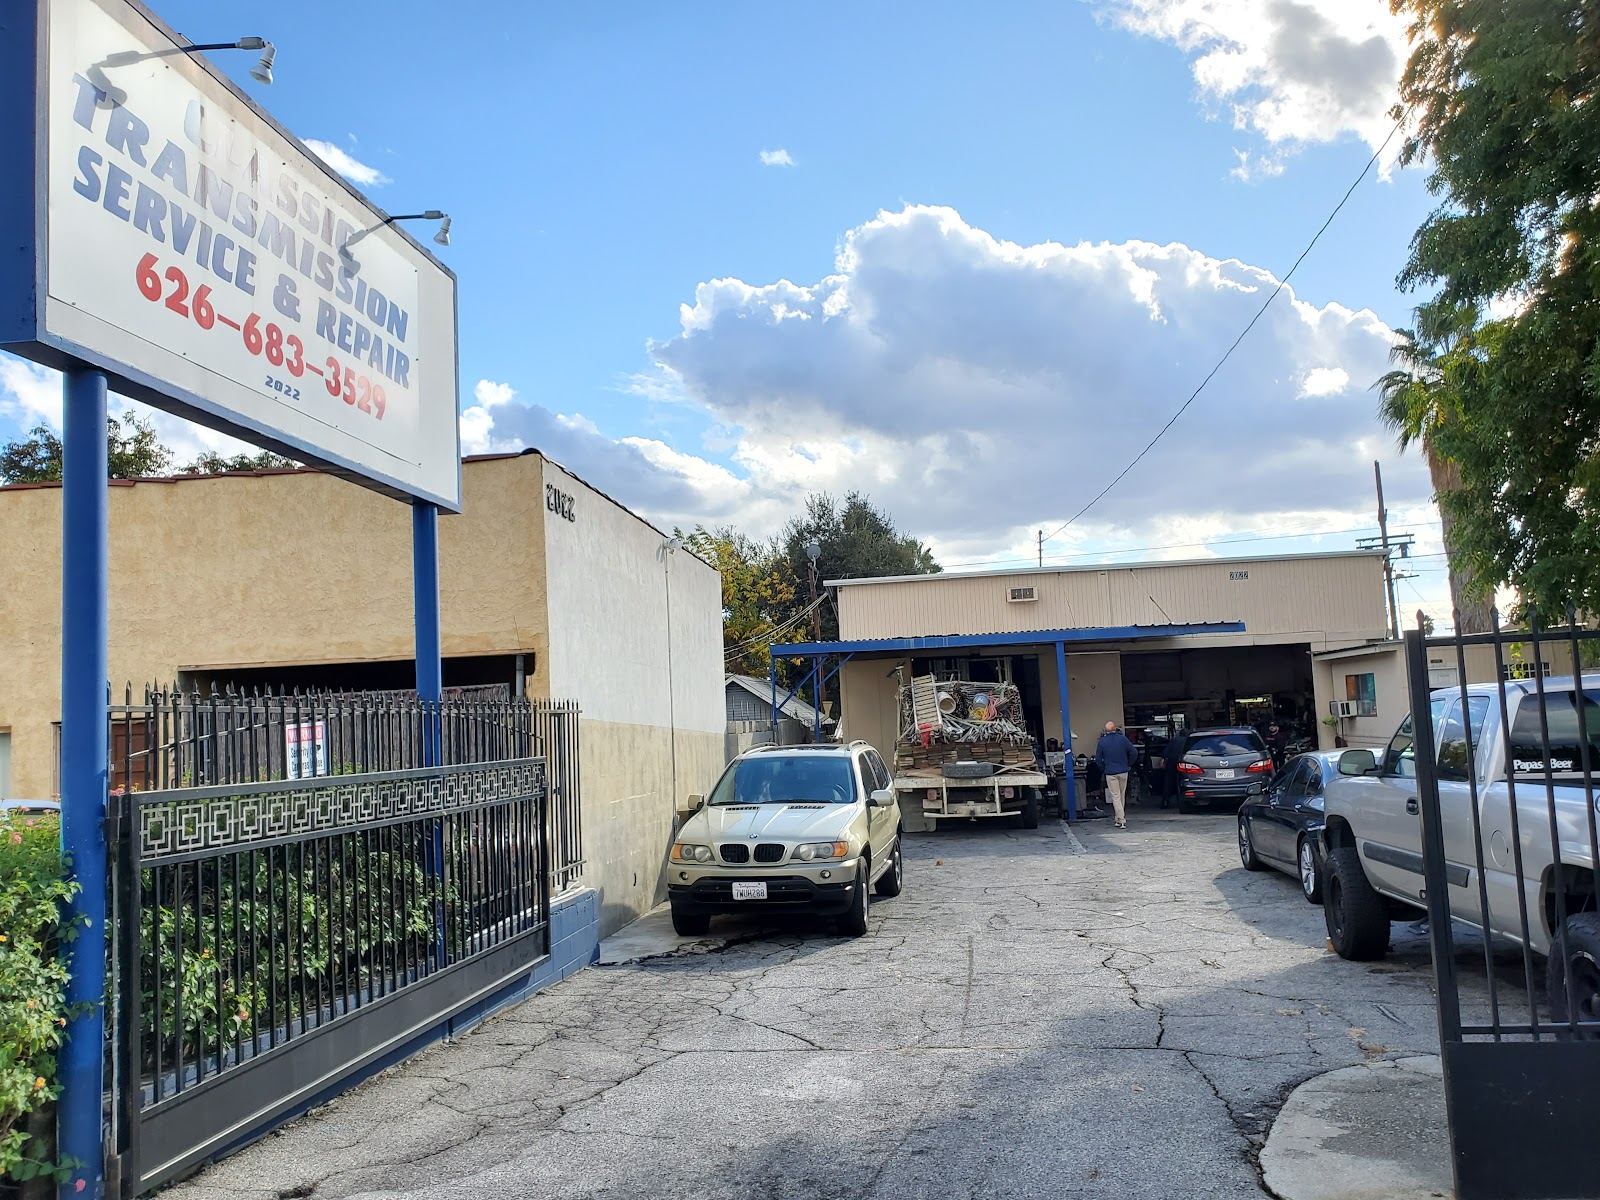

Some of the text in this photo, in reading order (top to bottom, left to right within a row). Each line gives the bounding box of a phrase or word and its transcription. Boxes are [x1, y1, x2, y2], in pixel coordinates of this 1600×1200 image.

[72, 72, 408, 343] TRANSMISSION
[73, 145, 410, 389] SERVICE & REPAIR
[135, 251, 386, 421] 626-683-3529
[265, 375, 300, 401] 2022
[546, 483, 575, 523] 2022
[1229, 570, 1249, 580] 2022
[288, 727, 322, 743] WARNIG
[1513, 758, 1573, 772] Papas Beer
